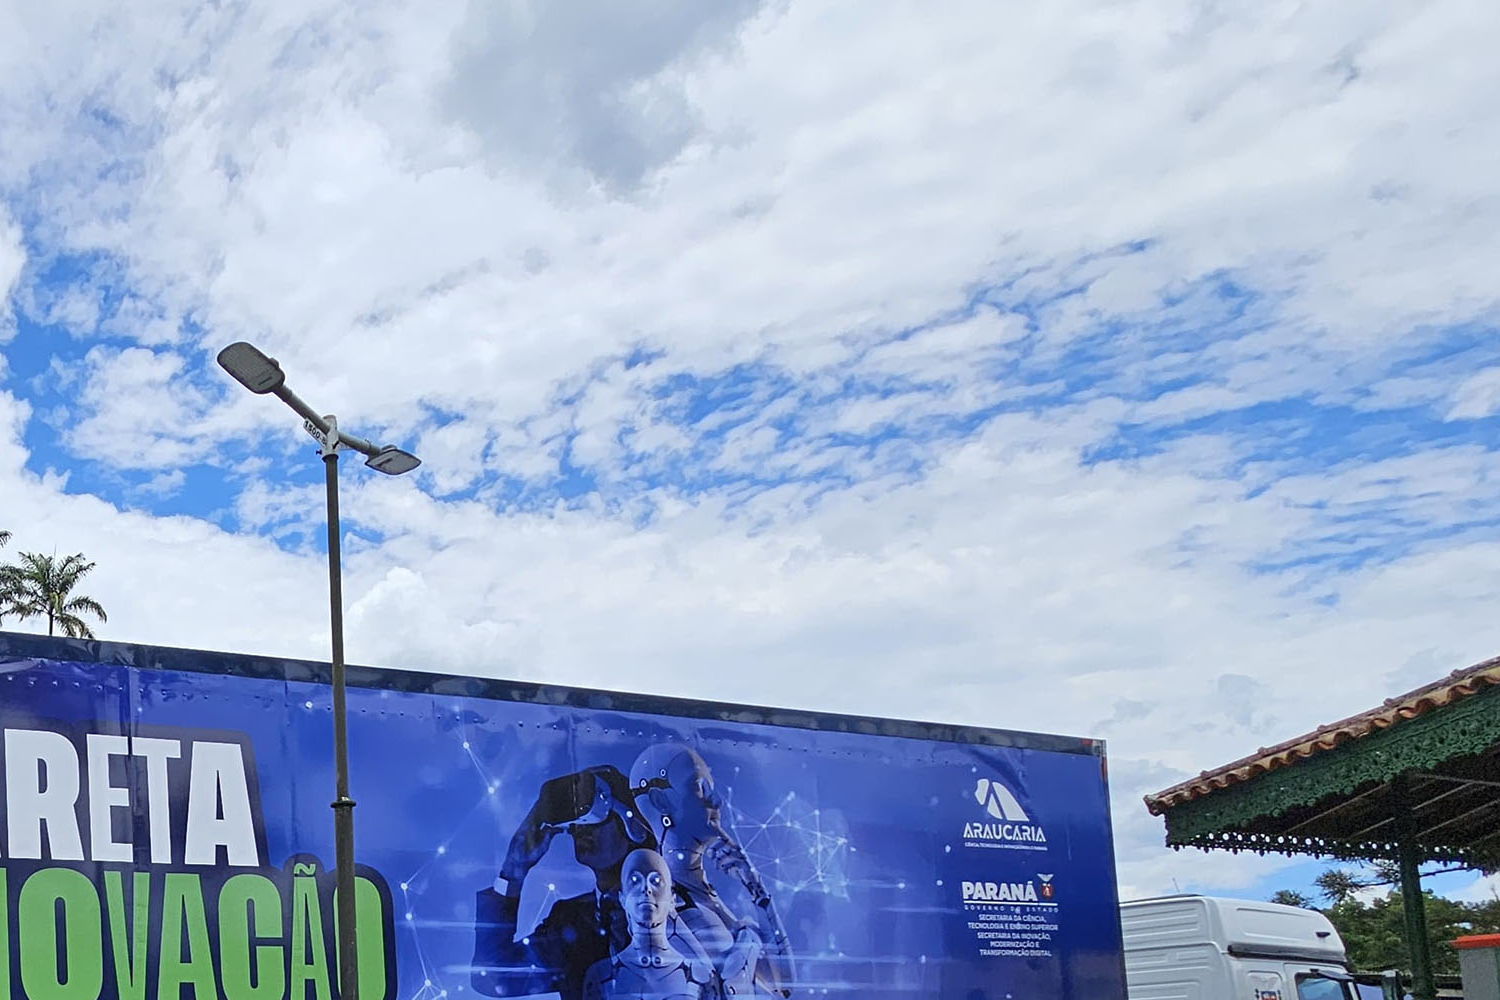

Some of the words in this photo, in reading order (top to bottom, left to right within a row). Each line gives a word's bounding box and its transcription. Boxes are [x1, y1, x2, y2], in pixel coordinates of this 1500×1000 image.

[963, 822, 1047, 842] ARAUCARIA
[961, 881, 1039, 901] PARANÁ
[963, 904, 1005, 912] GOVERNO
[978, 913, 1013, 921] SECRETARIA
